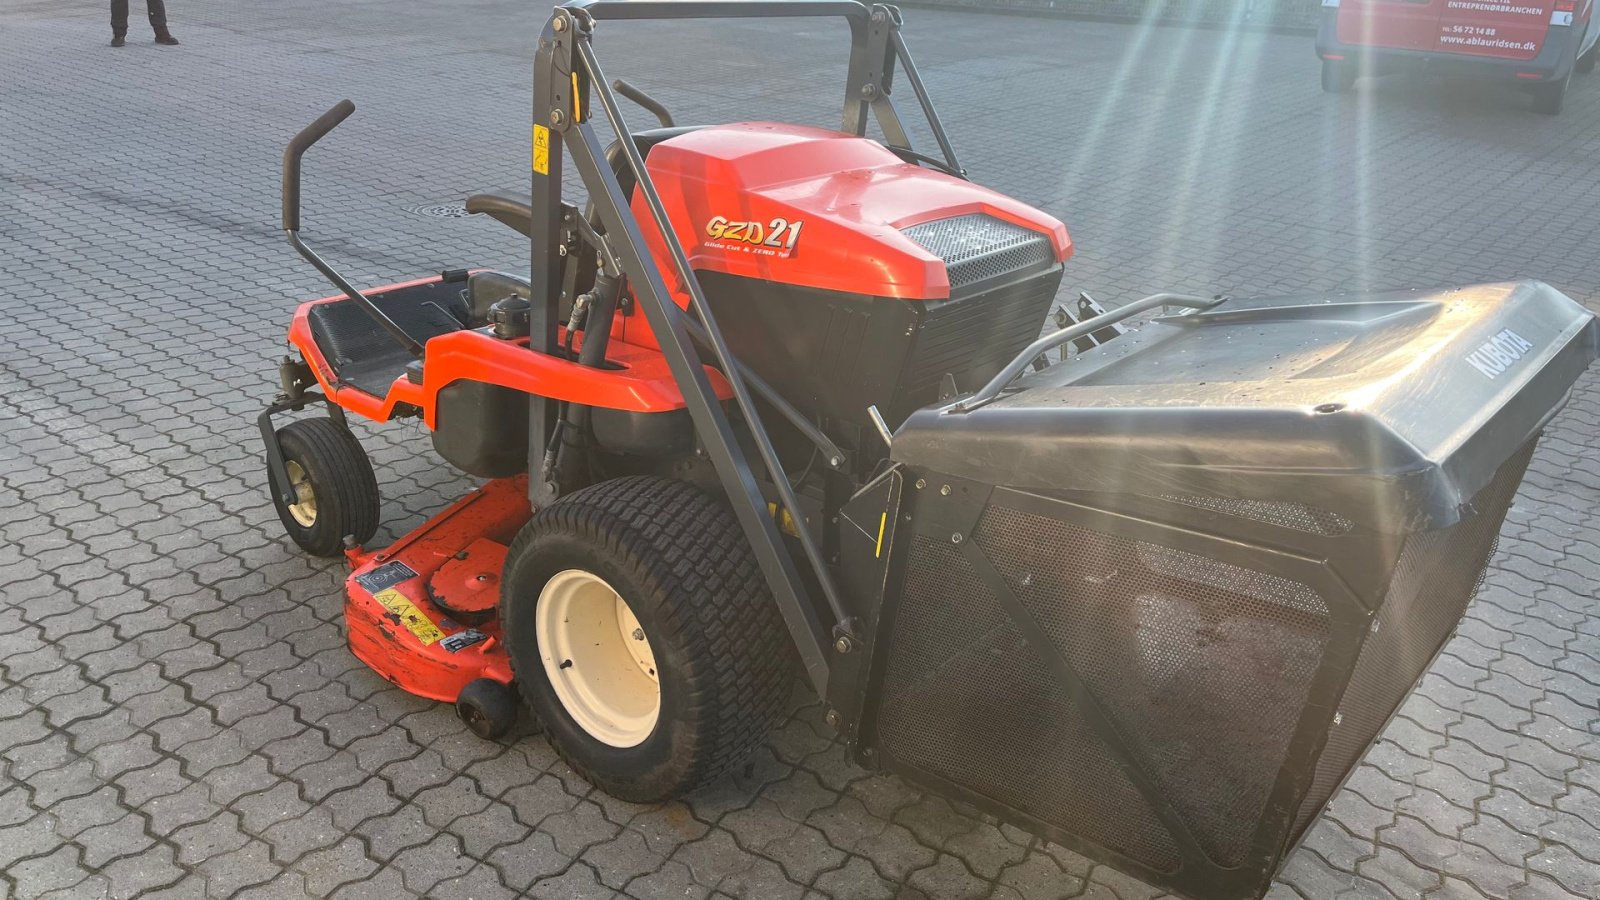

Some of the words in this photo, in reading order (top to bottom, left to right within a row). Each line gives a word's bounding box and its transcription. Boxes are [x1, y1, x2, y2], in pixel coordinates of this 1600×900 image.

[1447, 1, 1543, 15] ENTREPRENØRBRANCHEN
[1452, 25, 1463, 33] 56
[1464, 26, 1474, 34] 72
[1475, 27, 1484, 35] 14
[1485, 28, 1496, 36] 88
[1440, 35, 1536, 51] www.ablauridsen.dk
[703, 241, 725, 249] Glide
[752, 248, 775, 256] ZERO
[1464, 328, 1534, 380] KUBOTA
